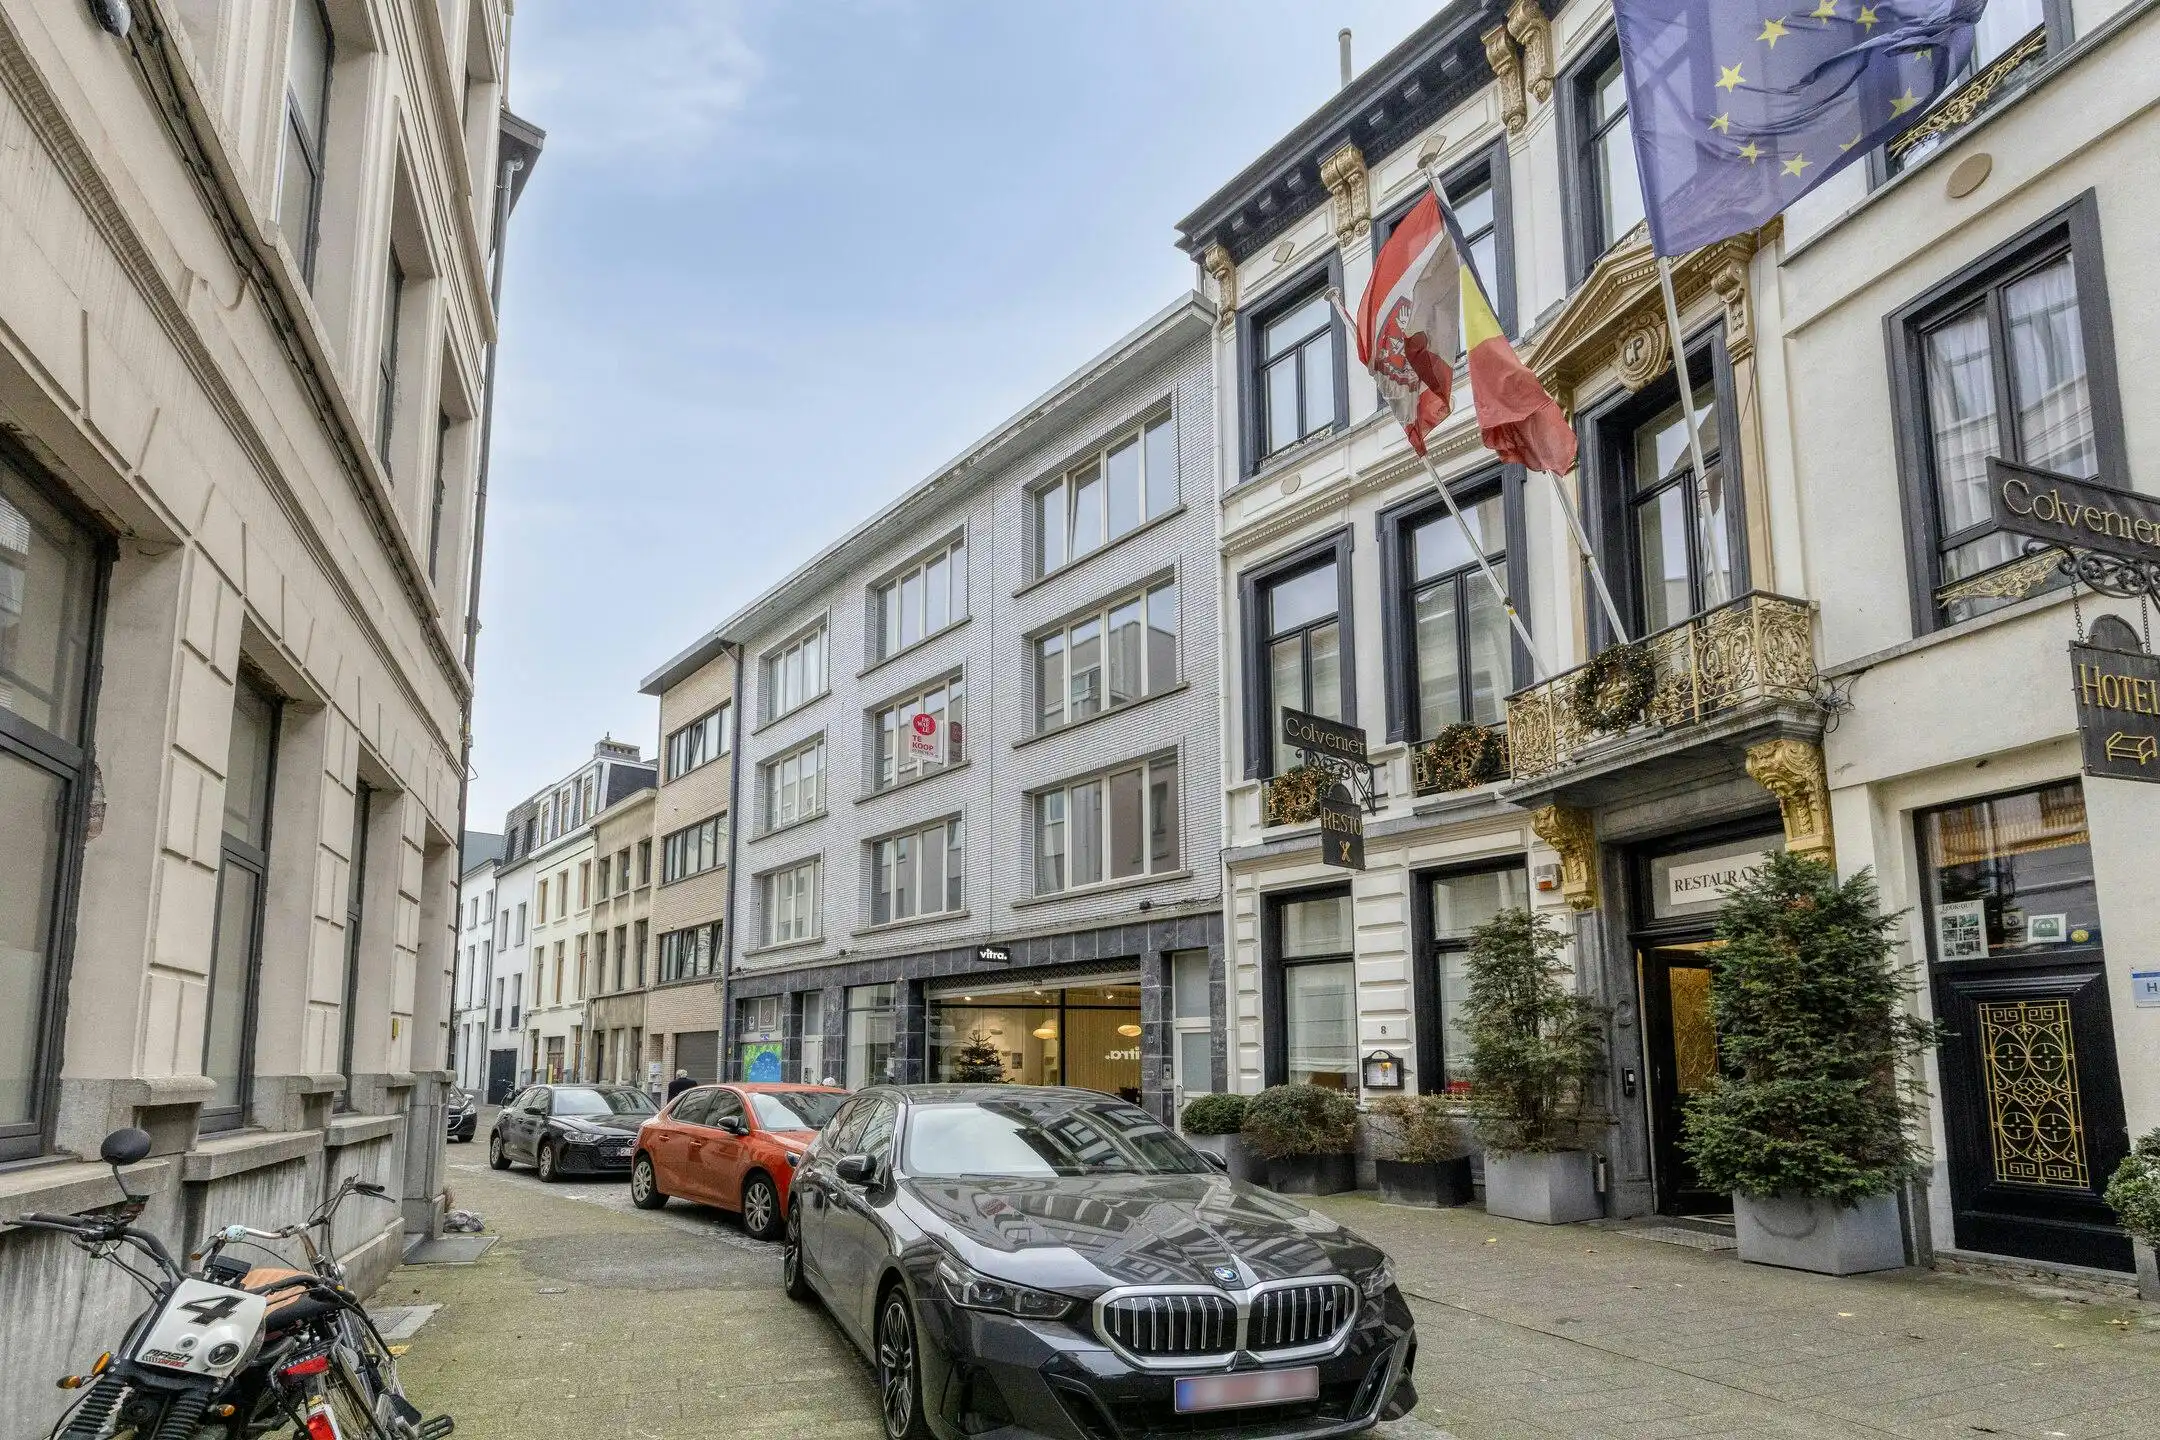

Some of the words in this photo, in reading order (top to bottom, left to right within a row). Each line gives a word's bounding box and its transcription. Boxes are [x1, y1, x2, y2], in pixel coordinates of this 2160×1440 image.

[912, 734, 922, 743] TE
[912, 742, 934, 752] KOOP
[1322, 806, 1362, 836] RESTO
[2146, 982, 2158, 993] H
[1380, 1025, 1388, 1035] 8
[177, 1294, 248, 1328] 4
